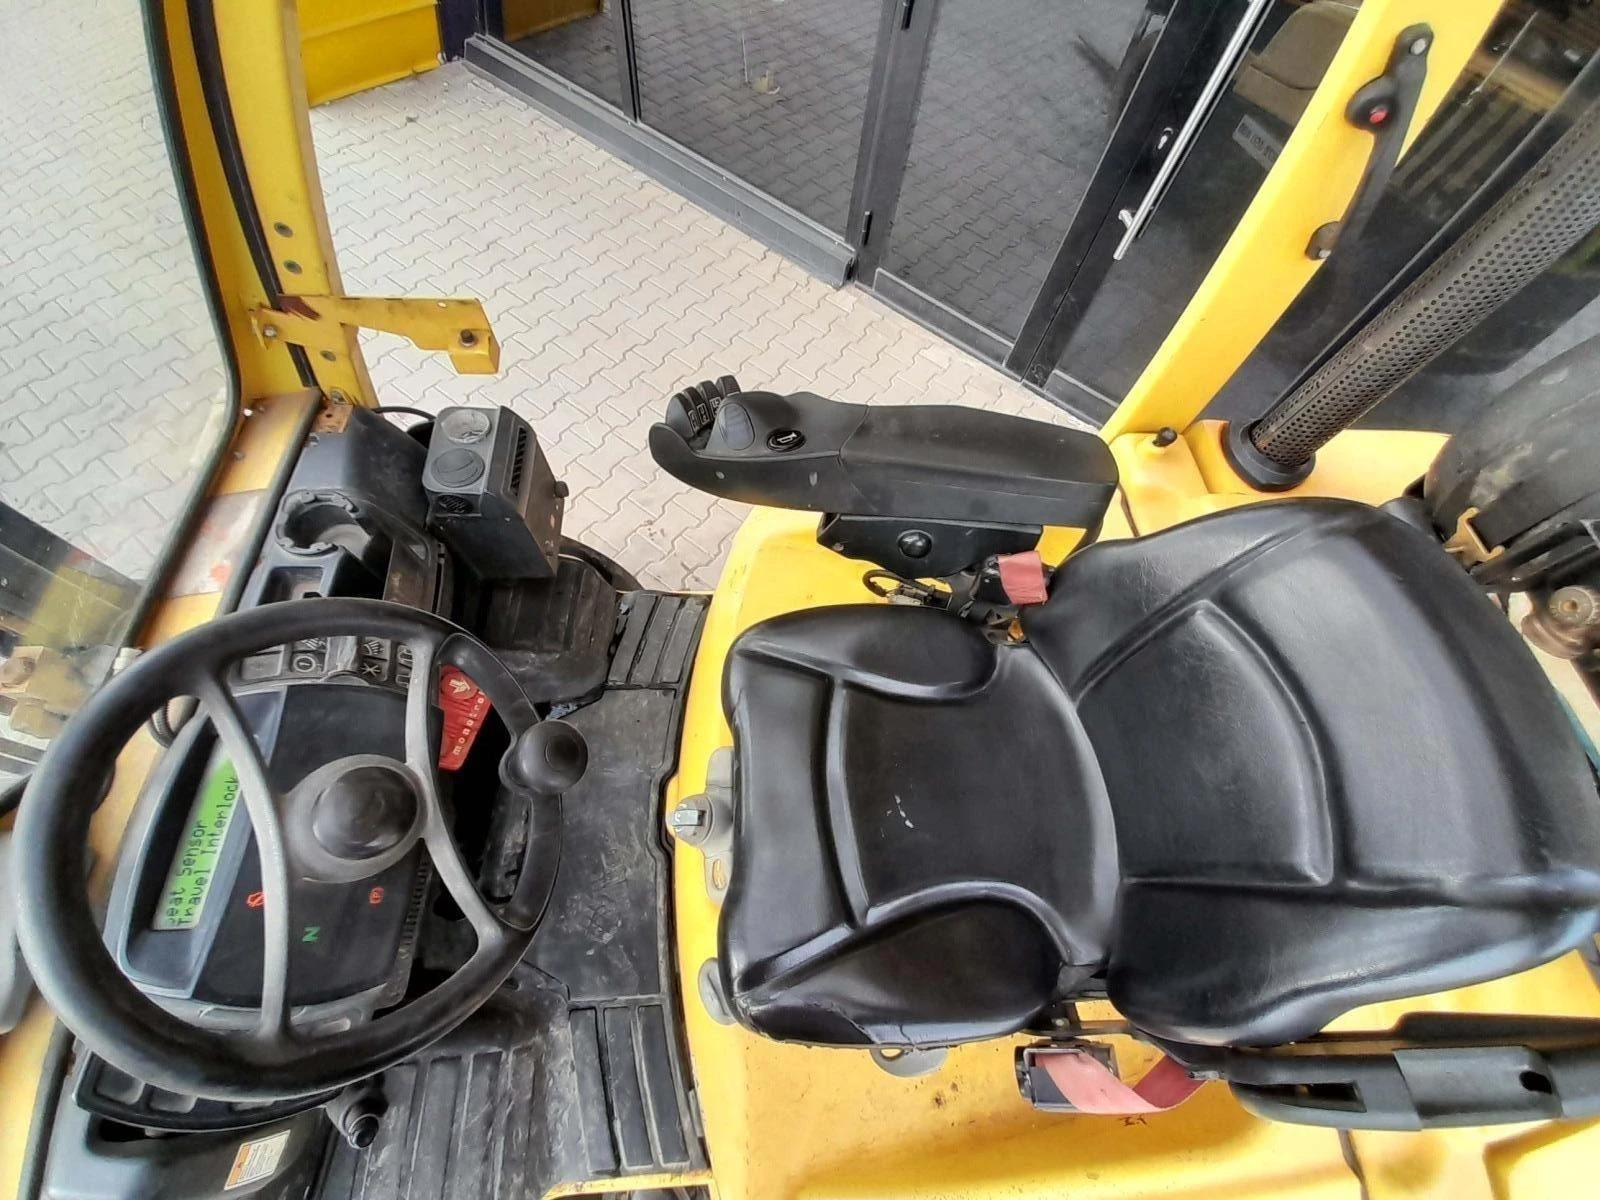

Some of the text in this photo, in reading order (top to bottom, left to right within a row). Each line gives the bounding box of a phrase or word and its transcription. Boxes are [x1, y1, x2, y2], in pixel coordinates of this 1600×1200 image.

[177, 820, 209, 877] Sensor
[178, 777, 240, 926] Travel Interlock
[302, 926, 320, 943] N
